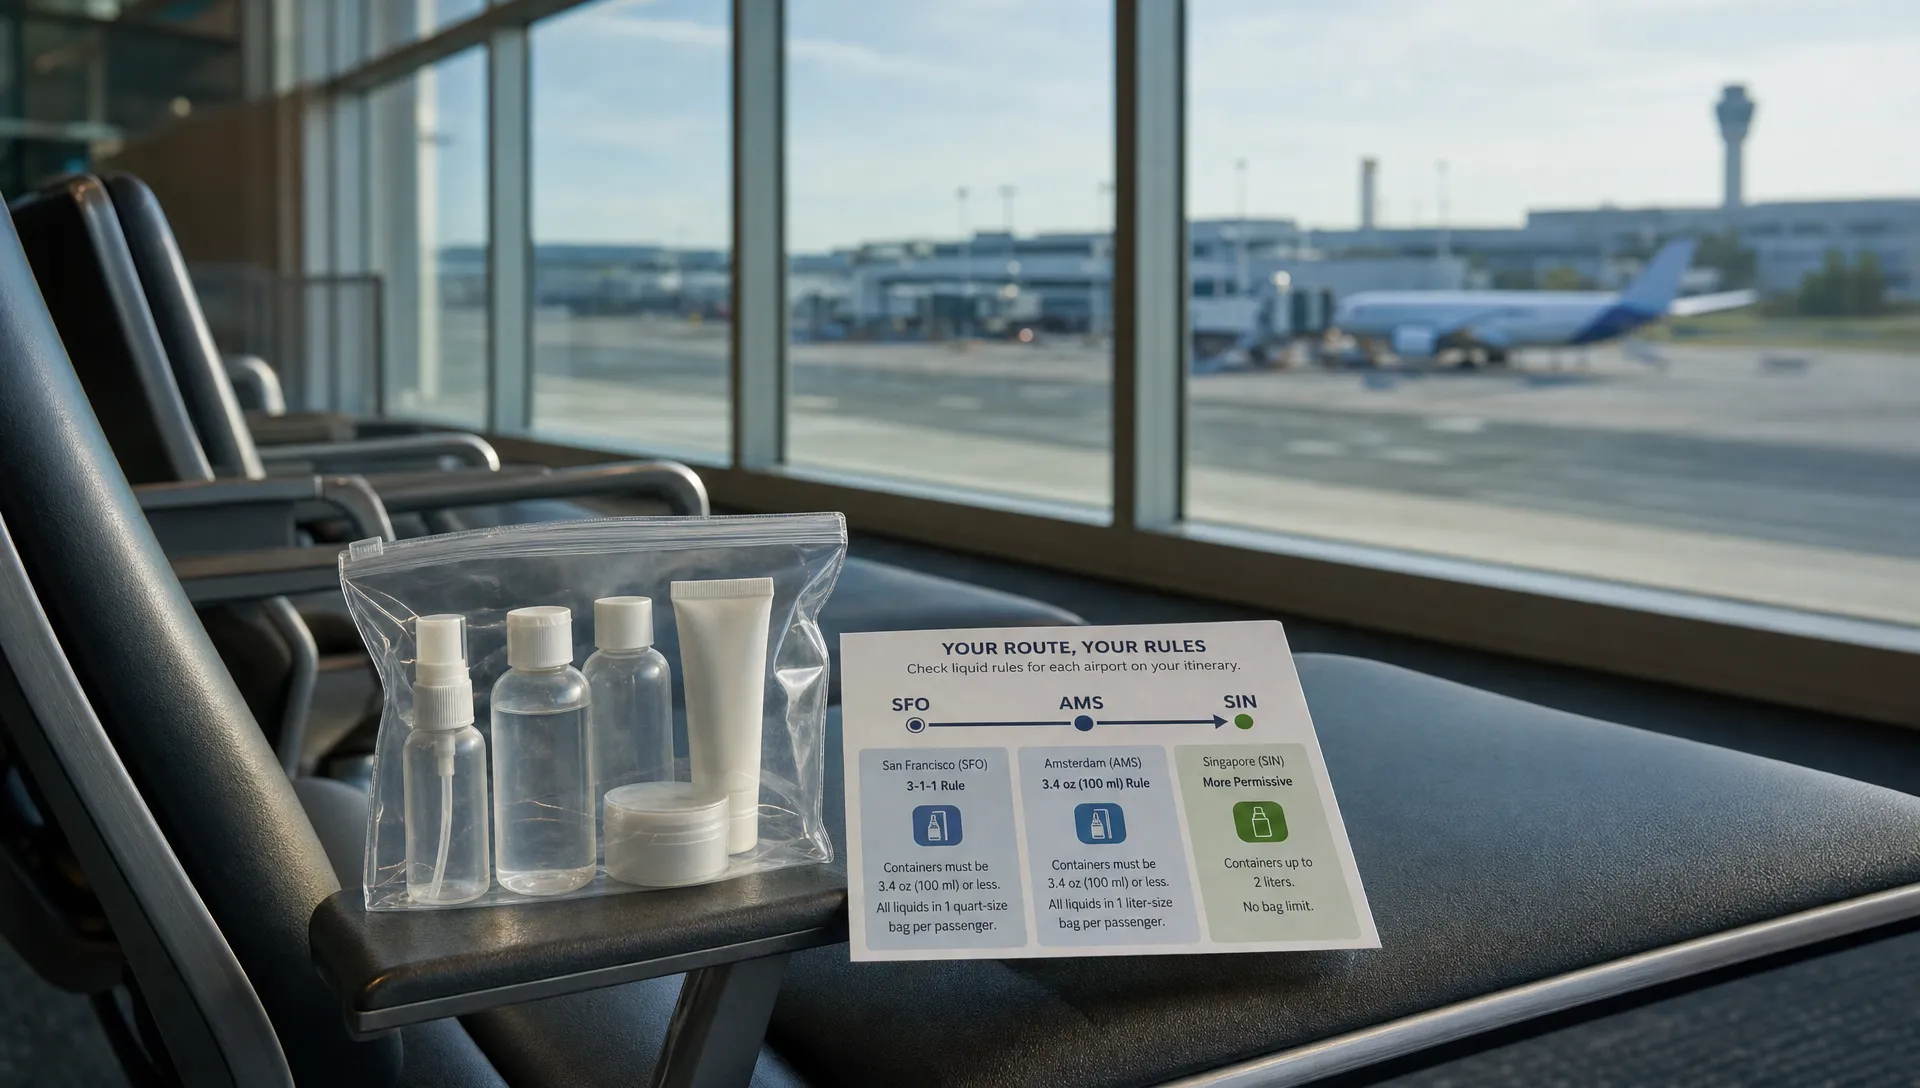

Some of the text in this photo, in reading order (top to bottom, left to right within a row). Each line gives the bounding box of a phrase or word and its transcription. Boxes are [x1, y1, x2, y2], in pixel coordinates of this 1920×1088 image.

[942, 640, 1206, 656] YOUR ROUTE, YOUR RULES
[907, 660, 1240, 675] Check liquid rules for each airport on your itinerary.
[892, 698, 929, 711] SFO
[1059, 696, 1103, 710] AMS
[1224, 695, 1257, 708] SIN
[883, 759, 987, 772] San Francisco (SFO)
[1045, 757, 1141, 770] Amsterdam (AMS)
[1203, 756, 1284, 769] Singapore (SIN)
[907, 780, 965, 791] 3-1-1 Rule
[1042, 779, 1060, 789] 3.4
[1079, 778, 1103, 791] (100
[1106, 778, 1123, 790] ml)
[1126, 778, 1150, 788] Rule
[1203, 776, 1292, 787] More Permissive
[884, 861, 988, 873] Containers must be
[1052, 859, 1156, 870] Containers must be
[1224, 858, 1312, 870] Containers up to
[879, 879, 1000, 893] 3.4 oz (100 ml) or less.
[1048, 876, 1169, 890] 3.4 oz (100 ml) or less.
[1254, 876, 1294, 887] 2 liters.
[877, 900, 1007, 915] All liquids in 1 quart-size
[1049, 897, 1172, 912] All liquids in 1 liter-size
[1243, 900, 1314, 914] No bag limit.
[889, 921, 996, 935] bag per passenger.
[1059, 917, 1165, 931] bag per passenger.
